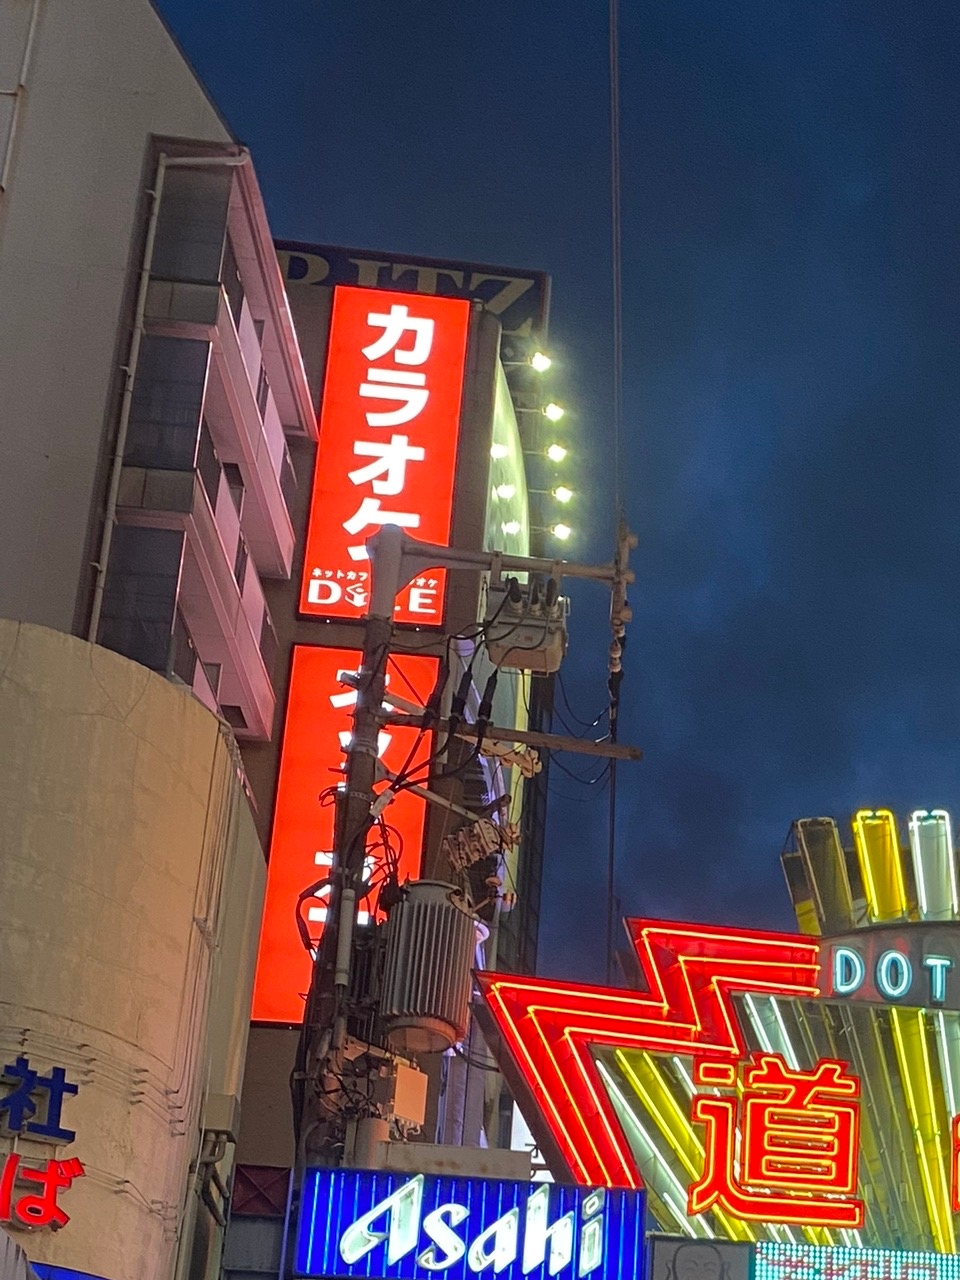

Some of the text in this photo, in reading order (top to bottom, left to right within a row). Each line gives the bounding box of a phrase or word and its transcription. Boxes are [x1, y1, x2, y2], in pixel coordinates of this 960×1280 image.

[0, 1056, 78, 1143] 社
[0, 1152, 84, 1230] ば
[340, 1173, 606, 1279] Asahi
